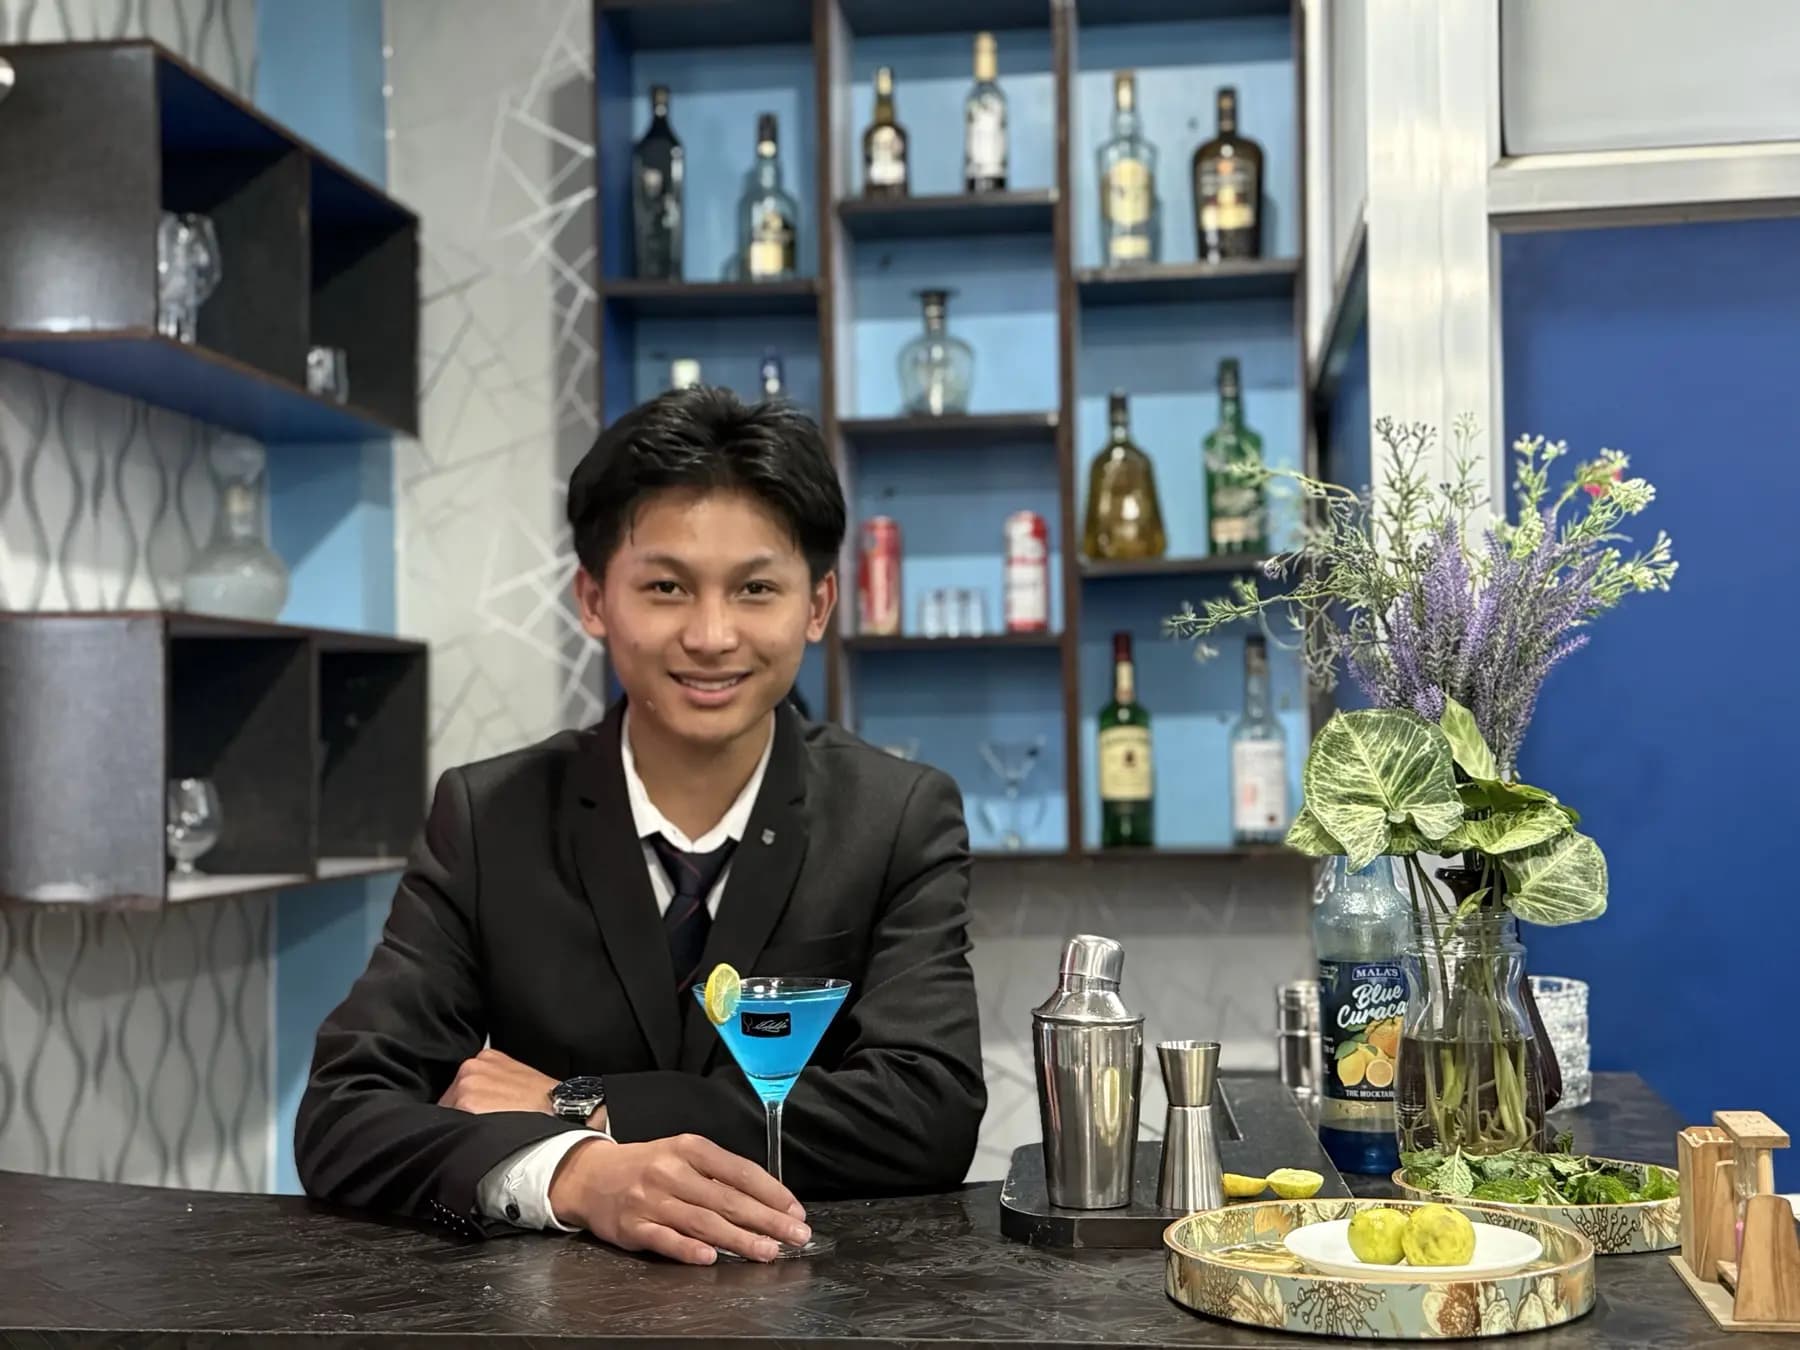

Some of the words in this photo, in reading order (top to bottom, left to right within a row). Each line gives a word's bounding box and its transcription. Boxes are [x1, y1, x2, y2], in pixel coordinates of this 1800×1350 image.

[1356, 968, 1398, 978] MALA'S
[1352, 983, 1403, 1009] Blue
[1337, 1000, 1408, 1028] Curaca
